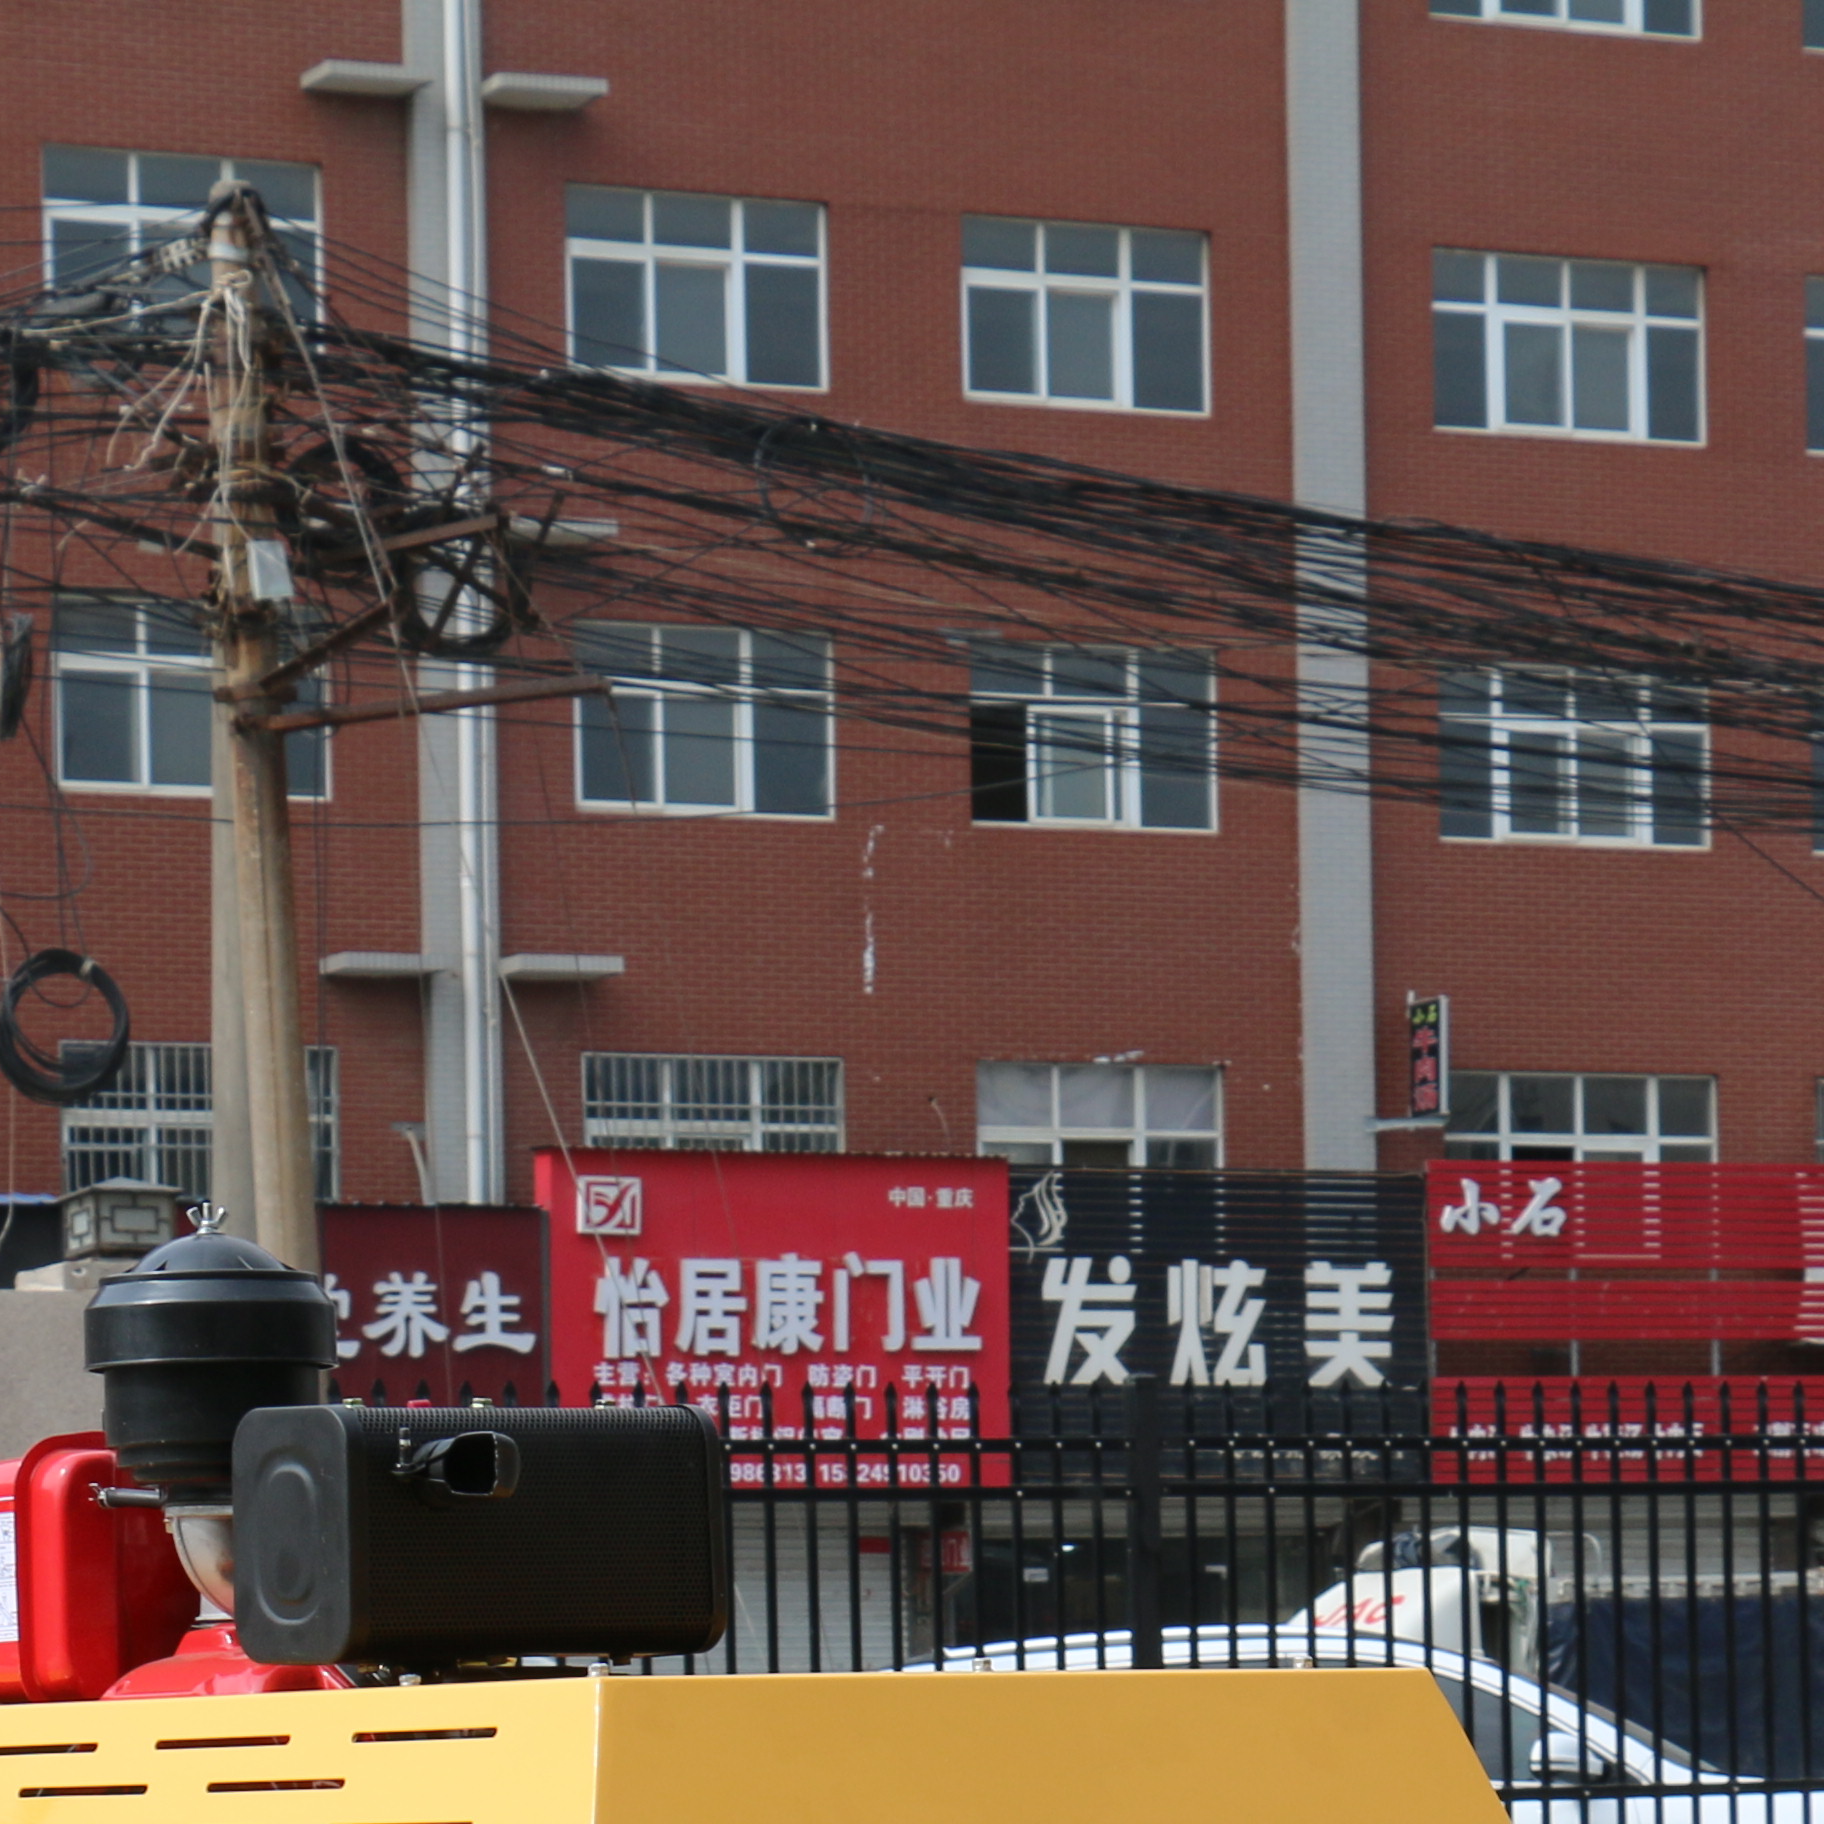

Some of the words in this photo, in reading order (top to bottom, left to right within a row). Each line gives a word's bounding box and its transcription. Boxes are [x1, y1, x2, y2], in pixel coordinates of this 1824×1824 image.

[888, 1186, 974, 1208] 中国·重庆
[1439, 1177, 1567, 1237] 小石
[594, 1252, 982, 1358] 怡居康门业
[1042, 1255, 1393, 1387] 发炫美
[808, 1363, 877, 1389] 防盗门
[902, 1365, 970, 1389] 平开门
